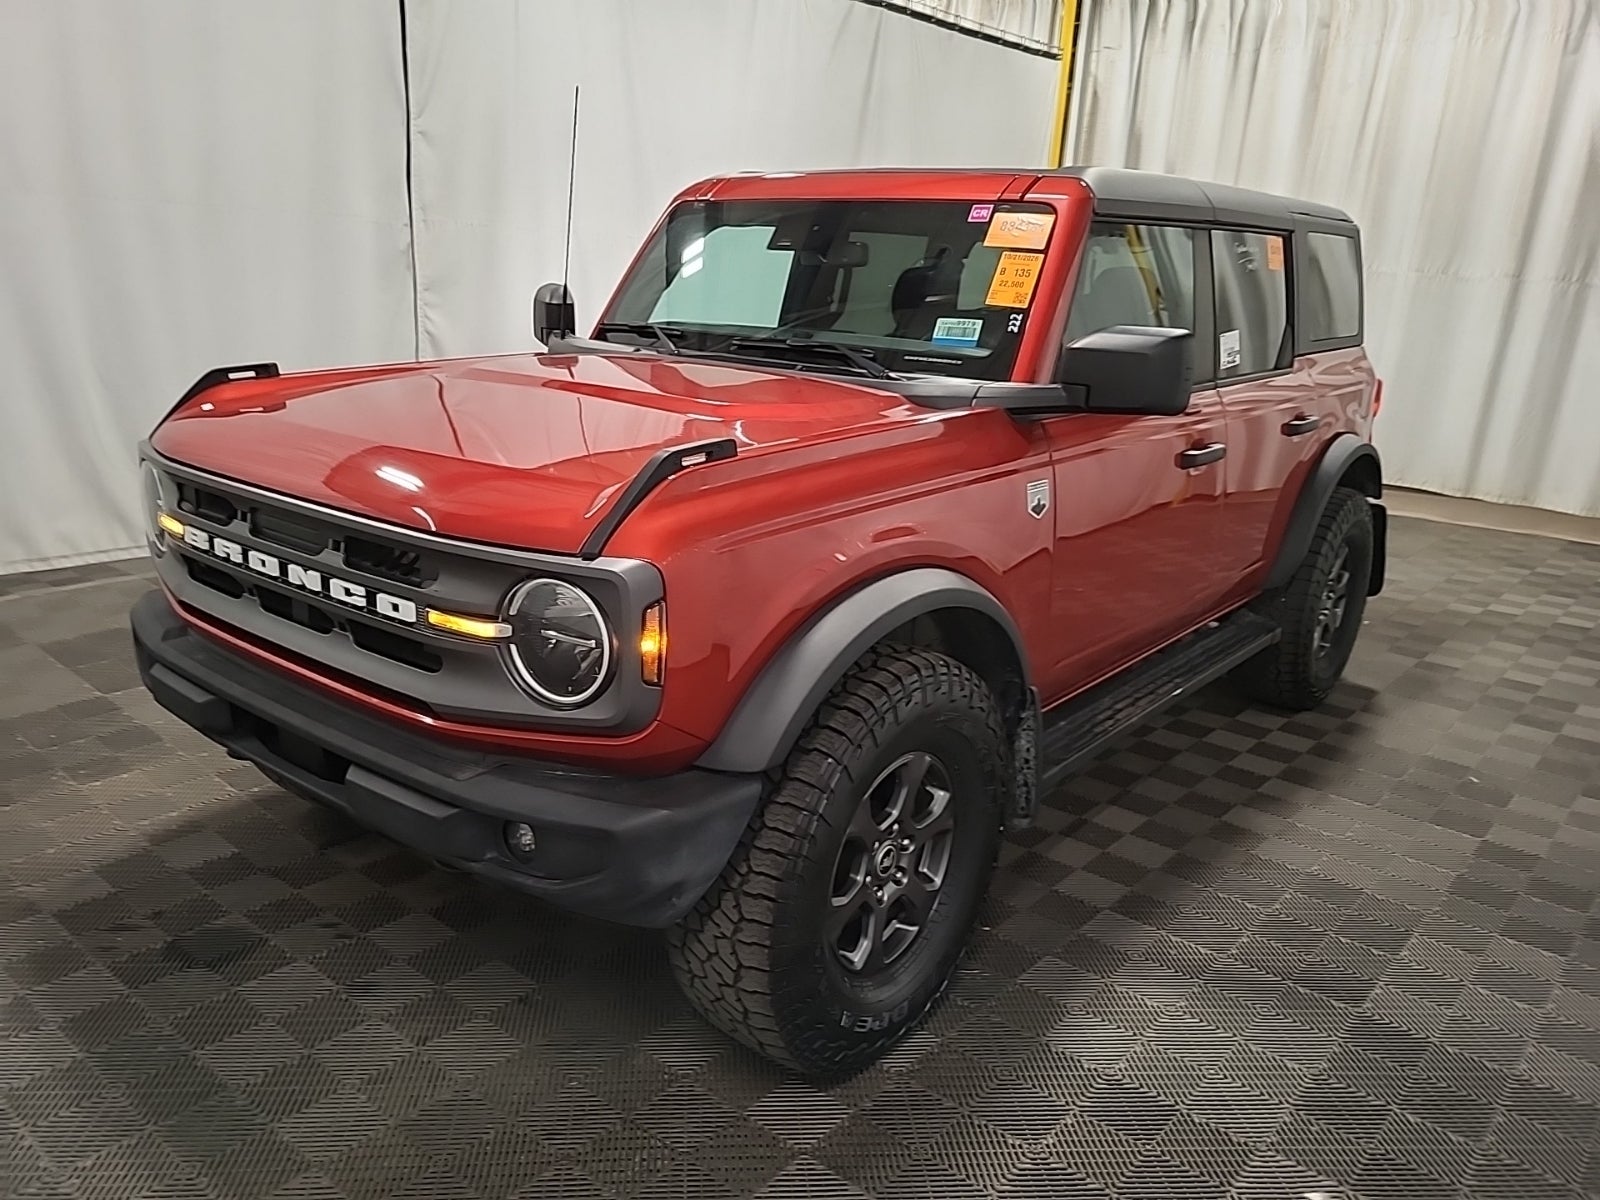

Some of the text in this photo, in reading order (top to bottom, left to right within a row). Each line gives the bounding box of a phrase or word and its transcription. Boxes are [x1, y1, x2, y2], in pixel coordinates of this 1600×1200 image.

[973, 209, 989, 218] CR
[1014, 268, 1032, 279] 135
[184, 525, 417, 623] BRONCO
